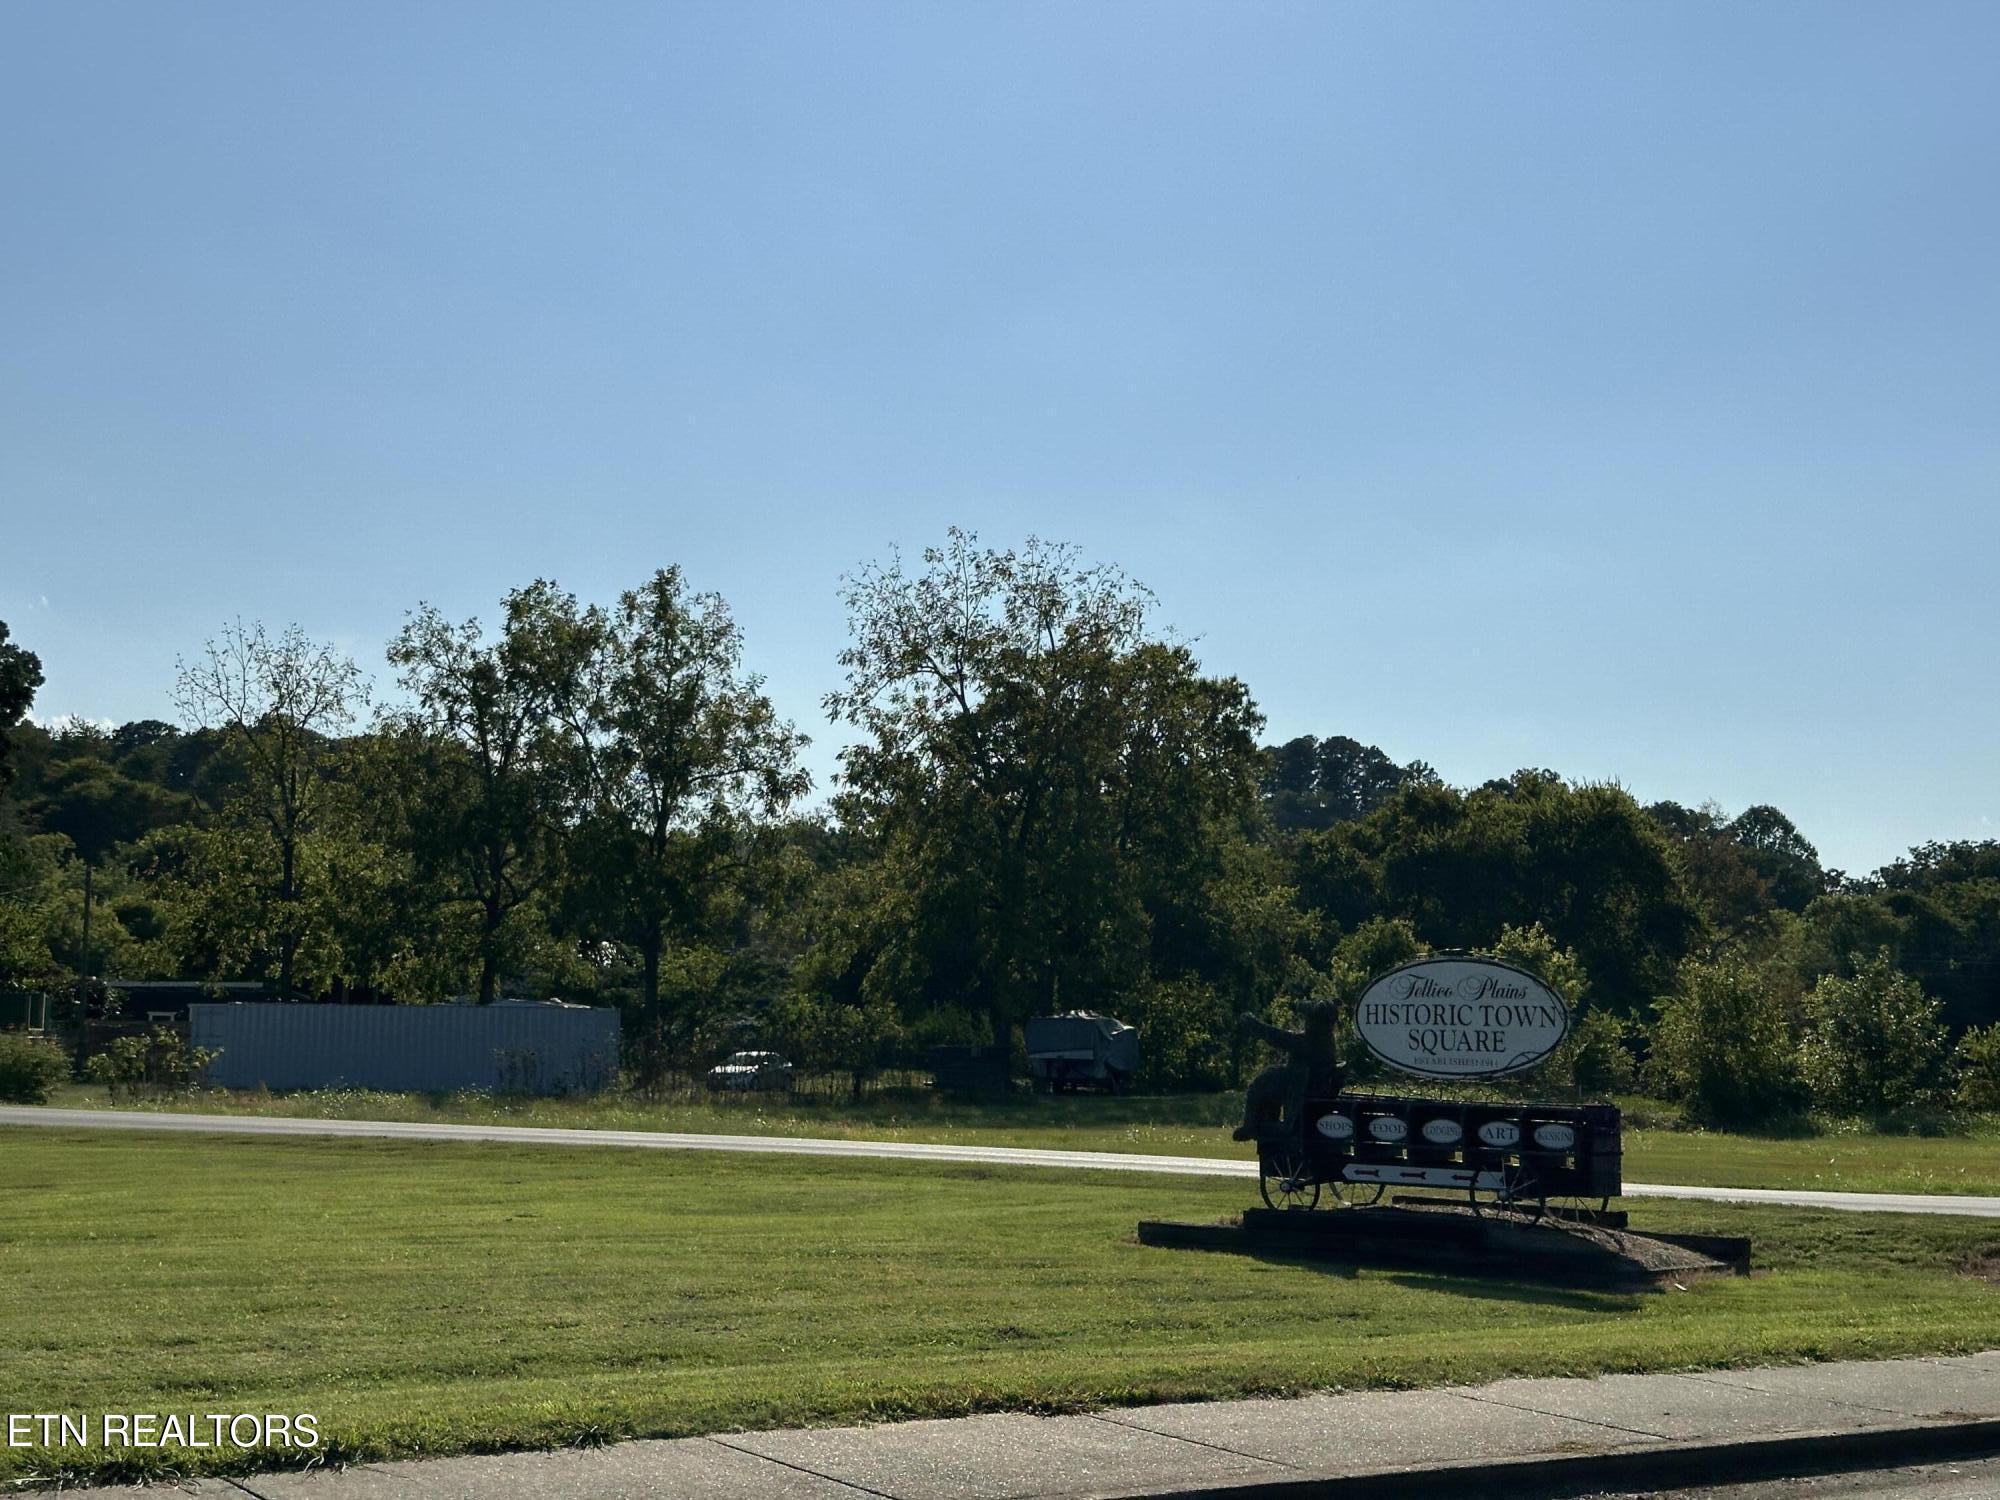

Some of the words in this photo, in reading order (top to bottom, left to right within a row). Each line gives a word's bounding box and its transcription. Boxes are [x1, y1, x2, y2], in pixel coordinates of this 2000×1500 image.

[1457, 974, 1528, 1002] Plains
[1365, 1003, 1473, 1027] HISTORIC
[1478, 1005, 1558, 1028] TOWN
[1408, 1029, 1507, 1055] SQUARE
[1484, 1126, 1517, 1140] ART
